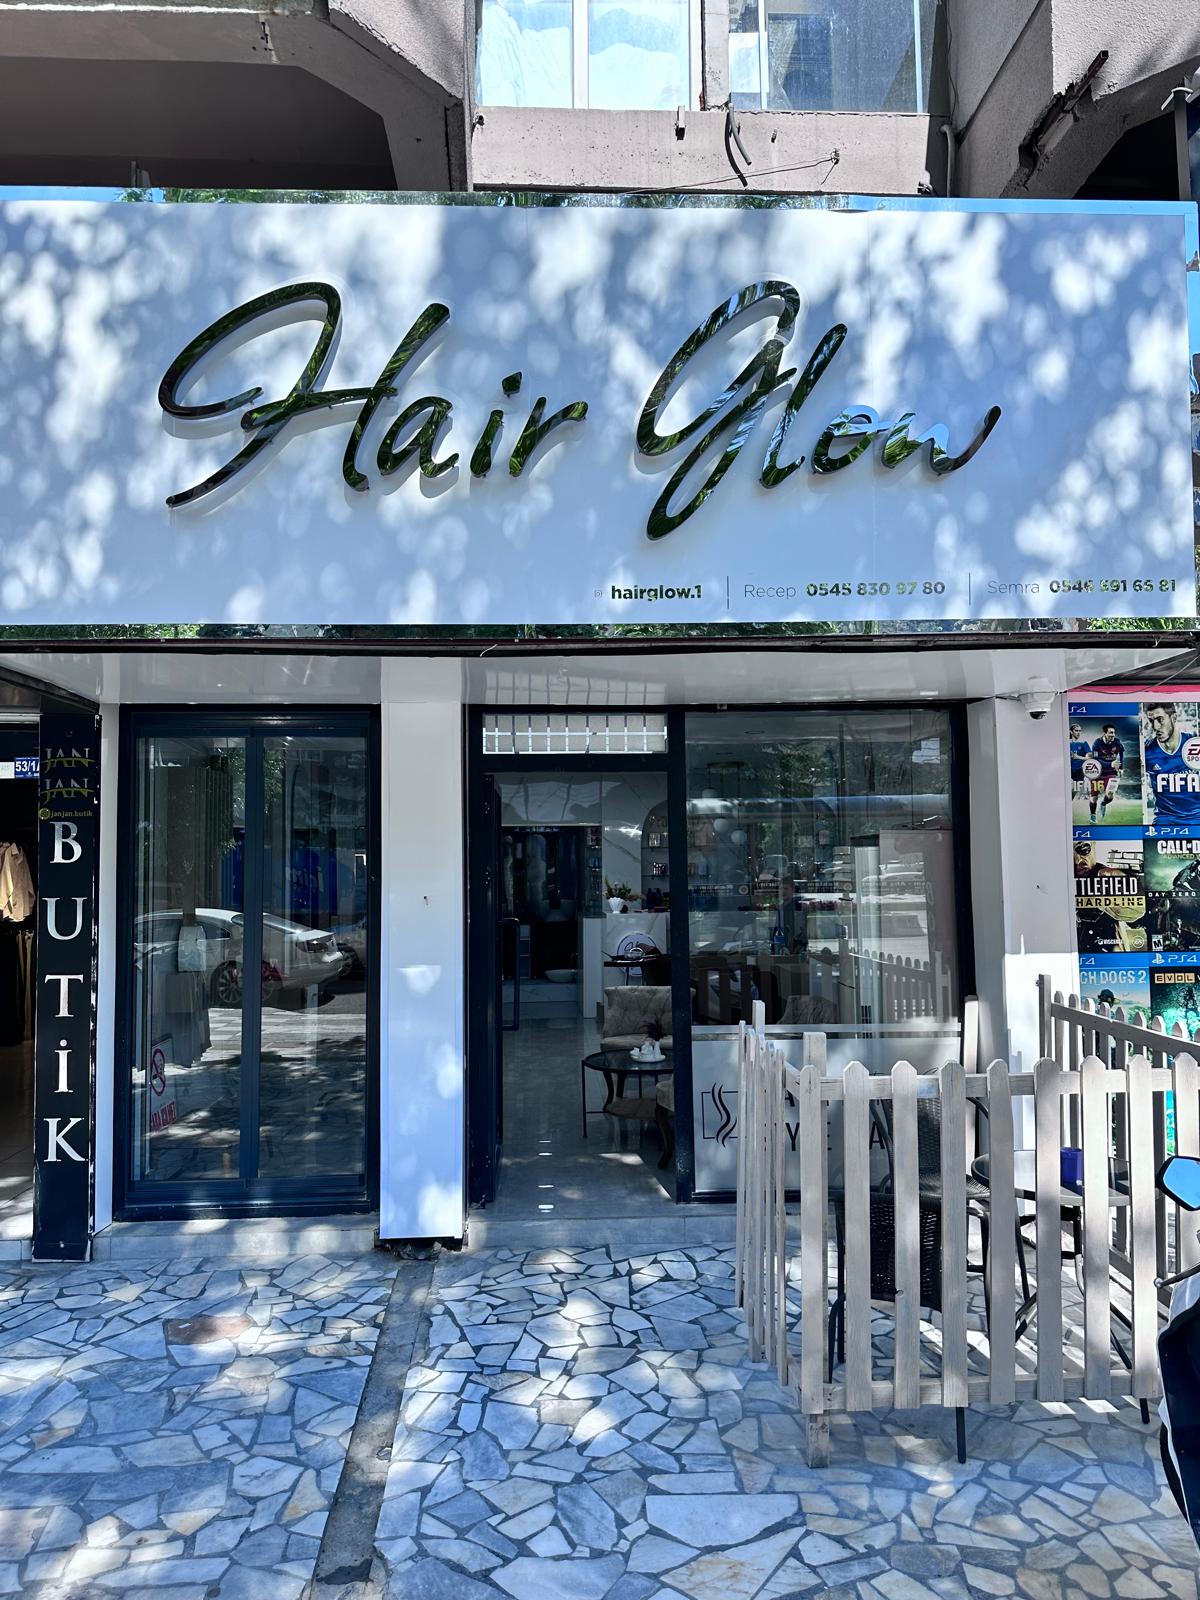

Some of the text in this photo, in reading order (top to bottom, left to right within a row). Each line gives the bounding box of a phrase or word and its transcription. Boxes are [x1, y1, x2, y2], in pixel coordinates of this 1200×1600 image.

[158, 279, 1002, 541] Hair Glow
[611, 585, 702, 601] hairglow.1
[744, 581, 946, 600] Recep 0545 830 97 80
[987, 580, 1040, 594] Semra
[1158, 579, 1176, 592] 81
[45, 748, 91, 773] JAN
[1092, 780, 1105, 792] 16
[1156, 773, 1200, 793] FIFA
[43, 778, 90, 804] JAN
[1161, 827, 1190, 835] PS4
[1076, 897, 1144, 907] HARDLINE
[1168, 955, 1197, 963] PS4
[1138, 970, 1147, 984] 2
